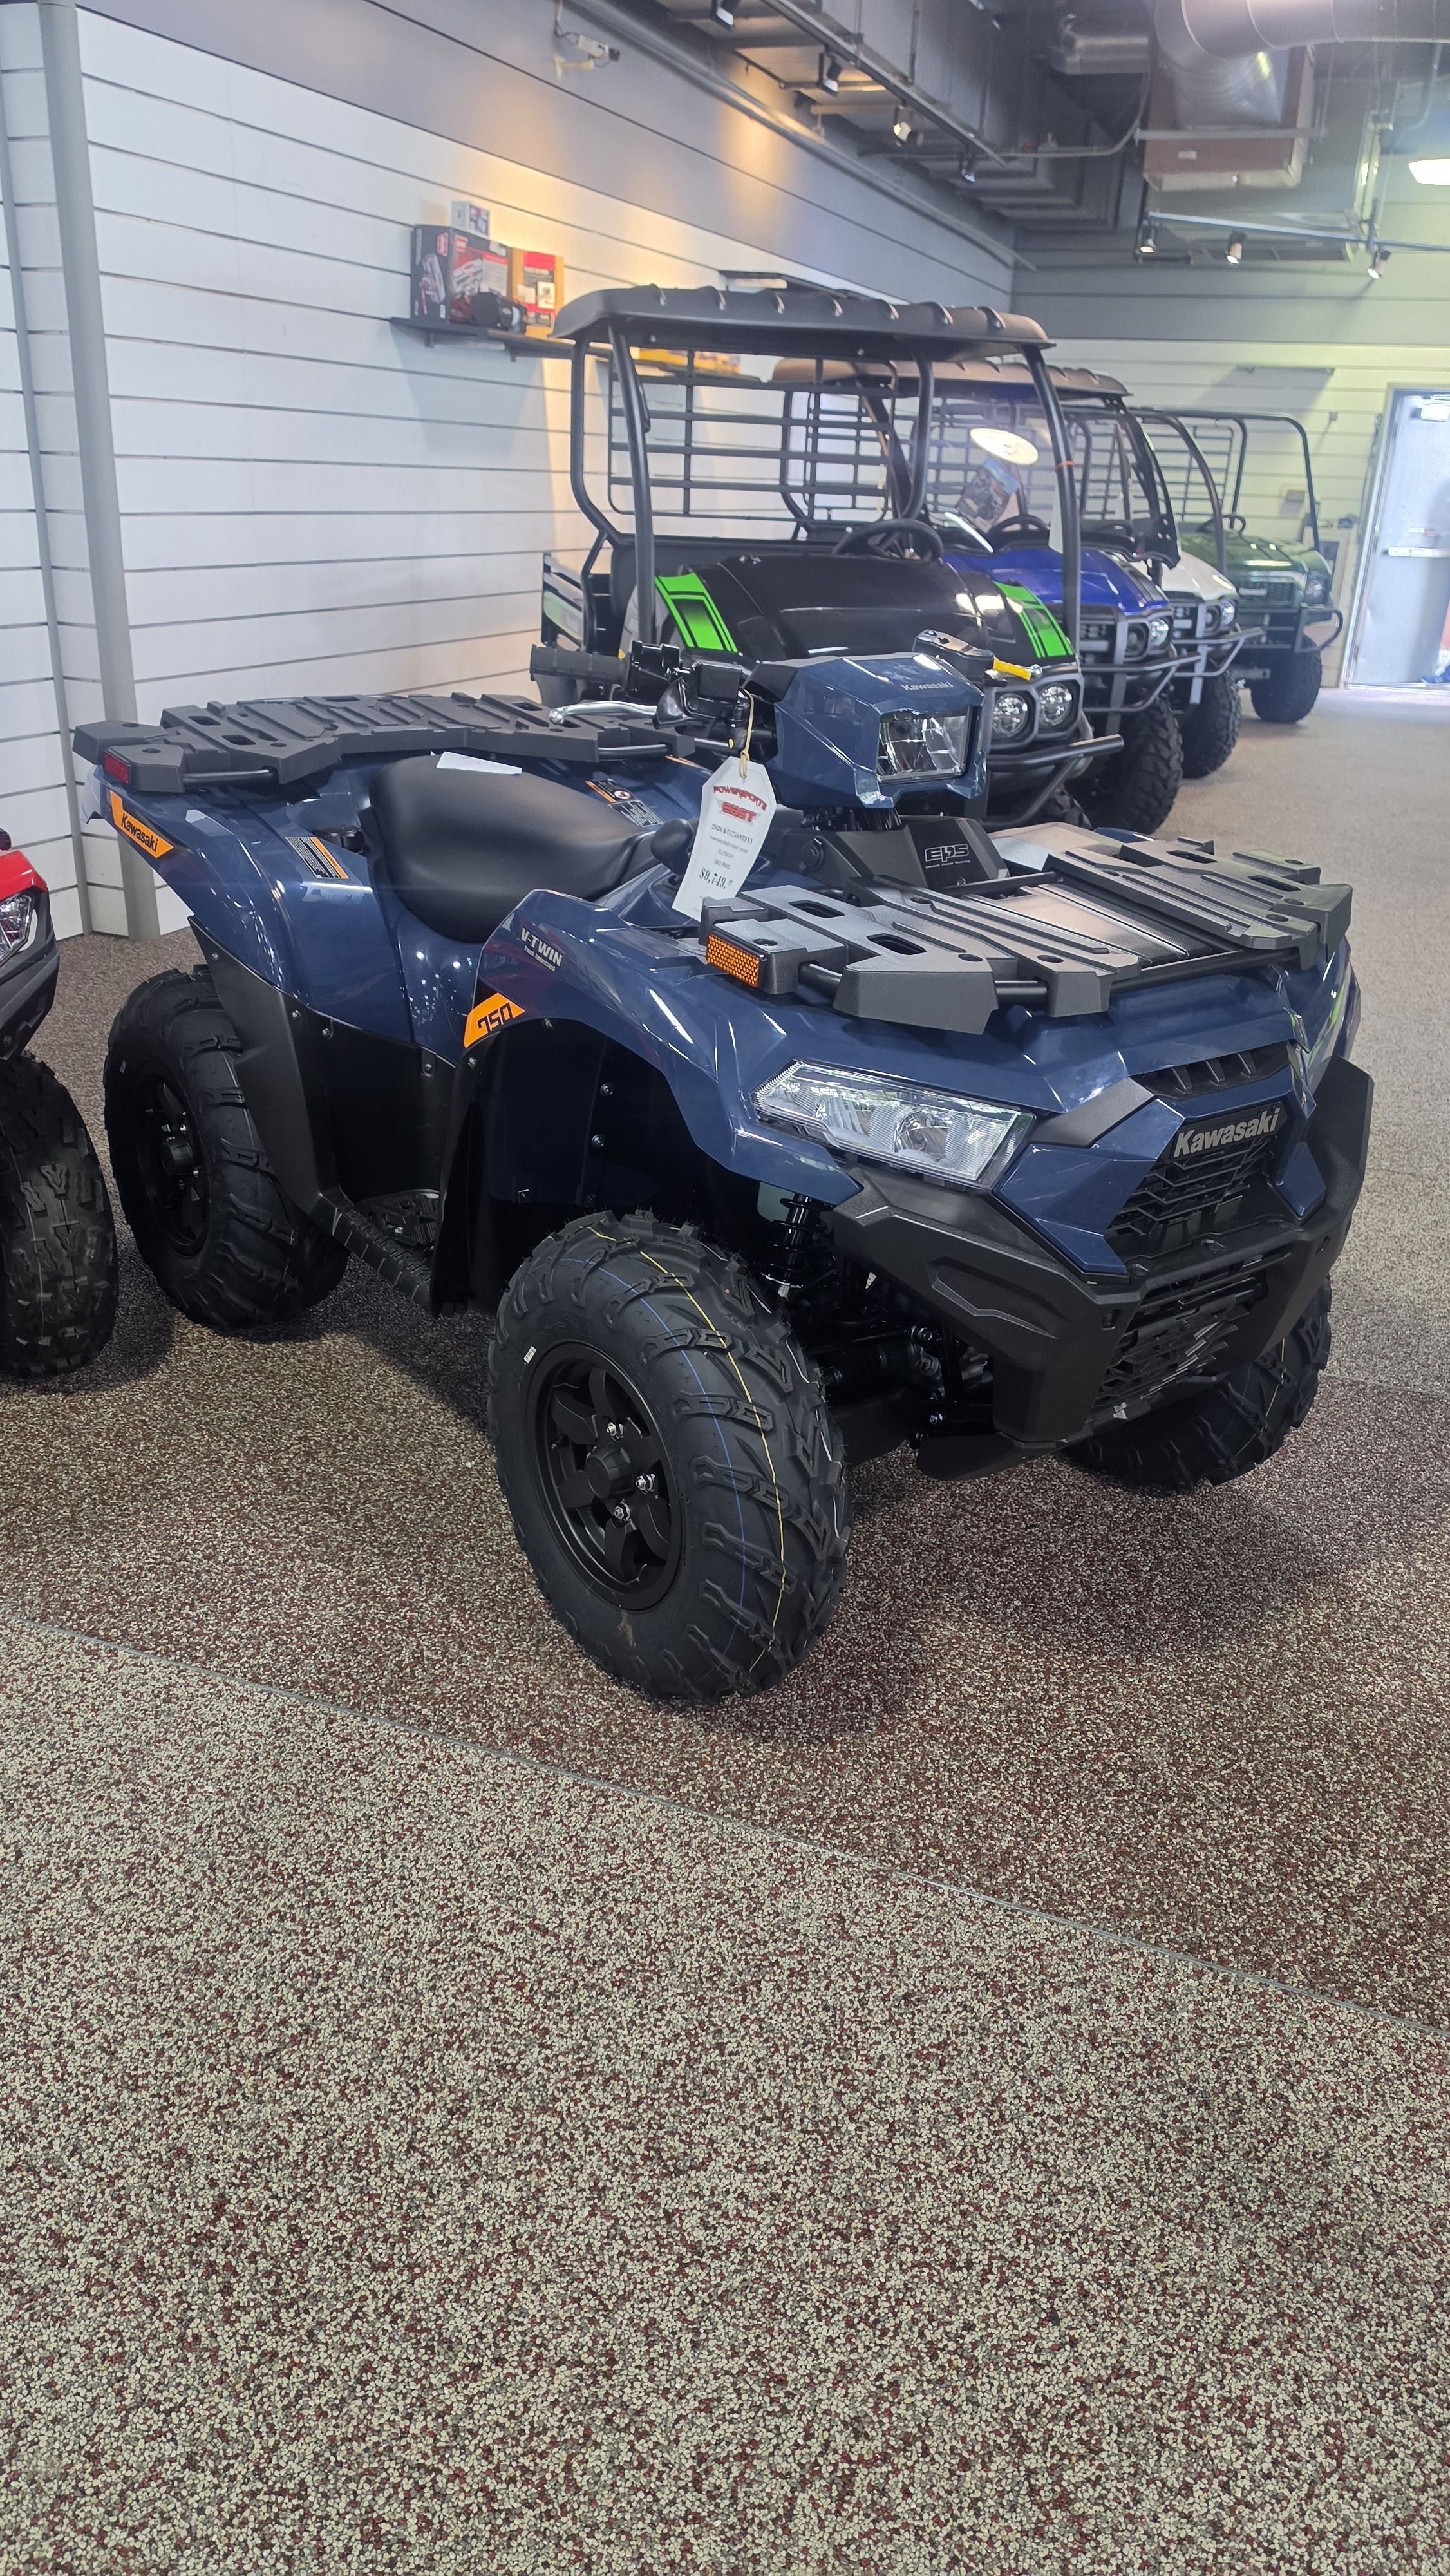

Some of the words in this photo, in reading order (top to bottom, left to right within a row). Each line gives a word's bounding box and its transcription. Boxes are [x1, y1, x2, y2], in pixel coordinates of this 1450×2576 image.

[901, 681, 954, 691] Kawasaki
[713, 786, 767, 811] POWERSPORTS
[121, 813, 158, 852] Kawasaki
[925, 844, 969, 862] EPS
[521, 927, 563, 967] V-TWIN
[523, 944, 535, 957] Fuel
[477, 1002, 513, 1033] 750
[1174, 1108, 1281, 1158] Kawasaki
